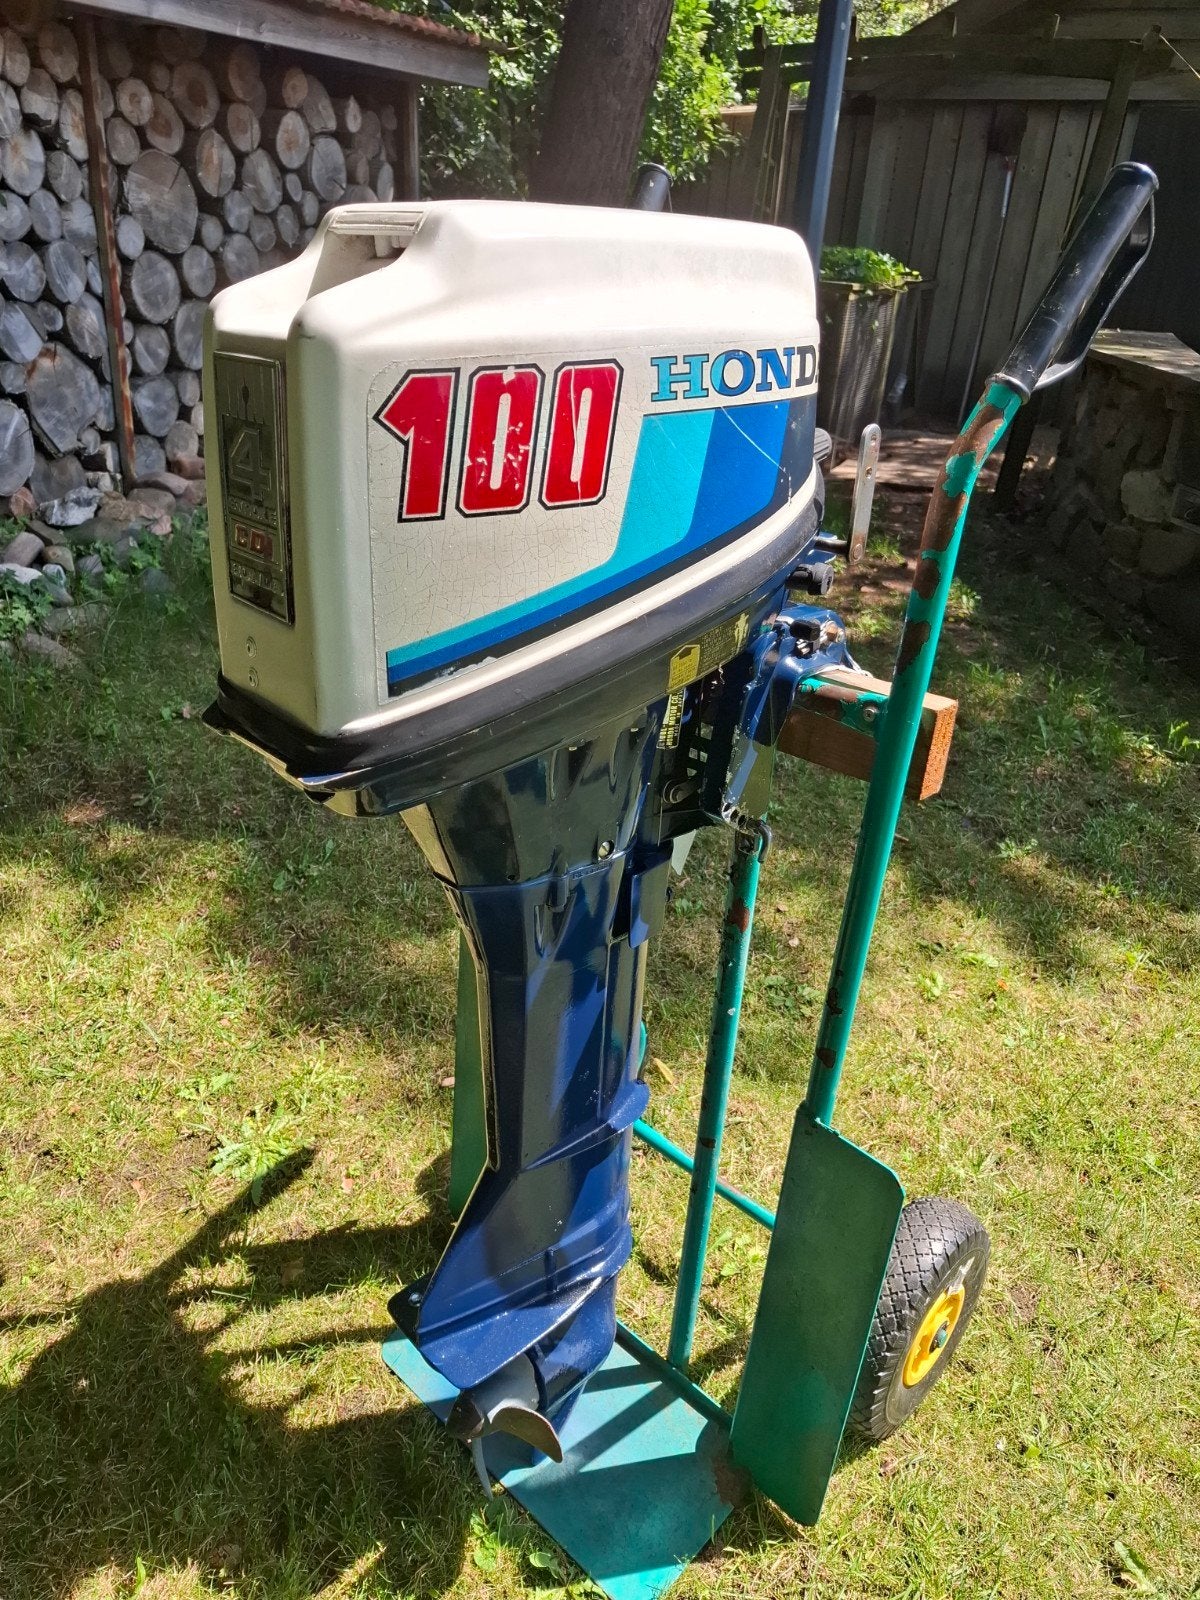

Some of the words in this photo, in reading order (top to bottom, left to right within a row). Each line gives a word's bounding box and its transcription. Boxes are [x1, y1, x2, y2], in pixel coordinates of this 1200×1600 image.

[651, 345, 818, 402] HOND
[372, 358, 624, 523] 100
[229, 428, 272, 502] 4
[234, 522, 274, 561] CDI
[666, 727, 674, 746] HONDA
[669, 705, 678, 726] MOTOR
